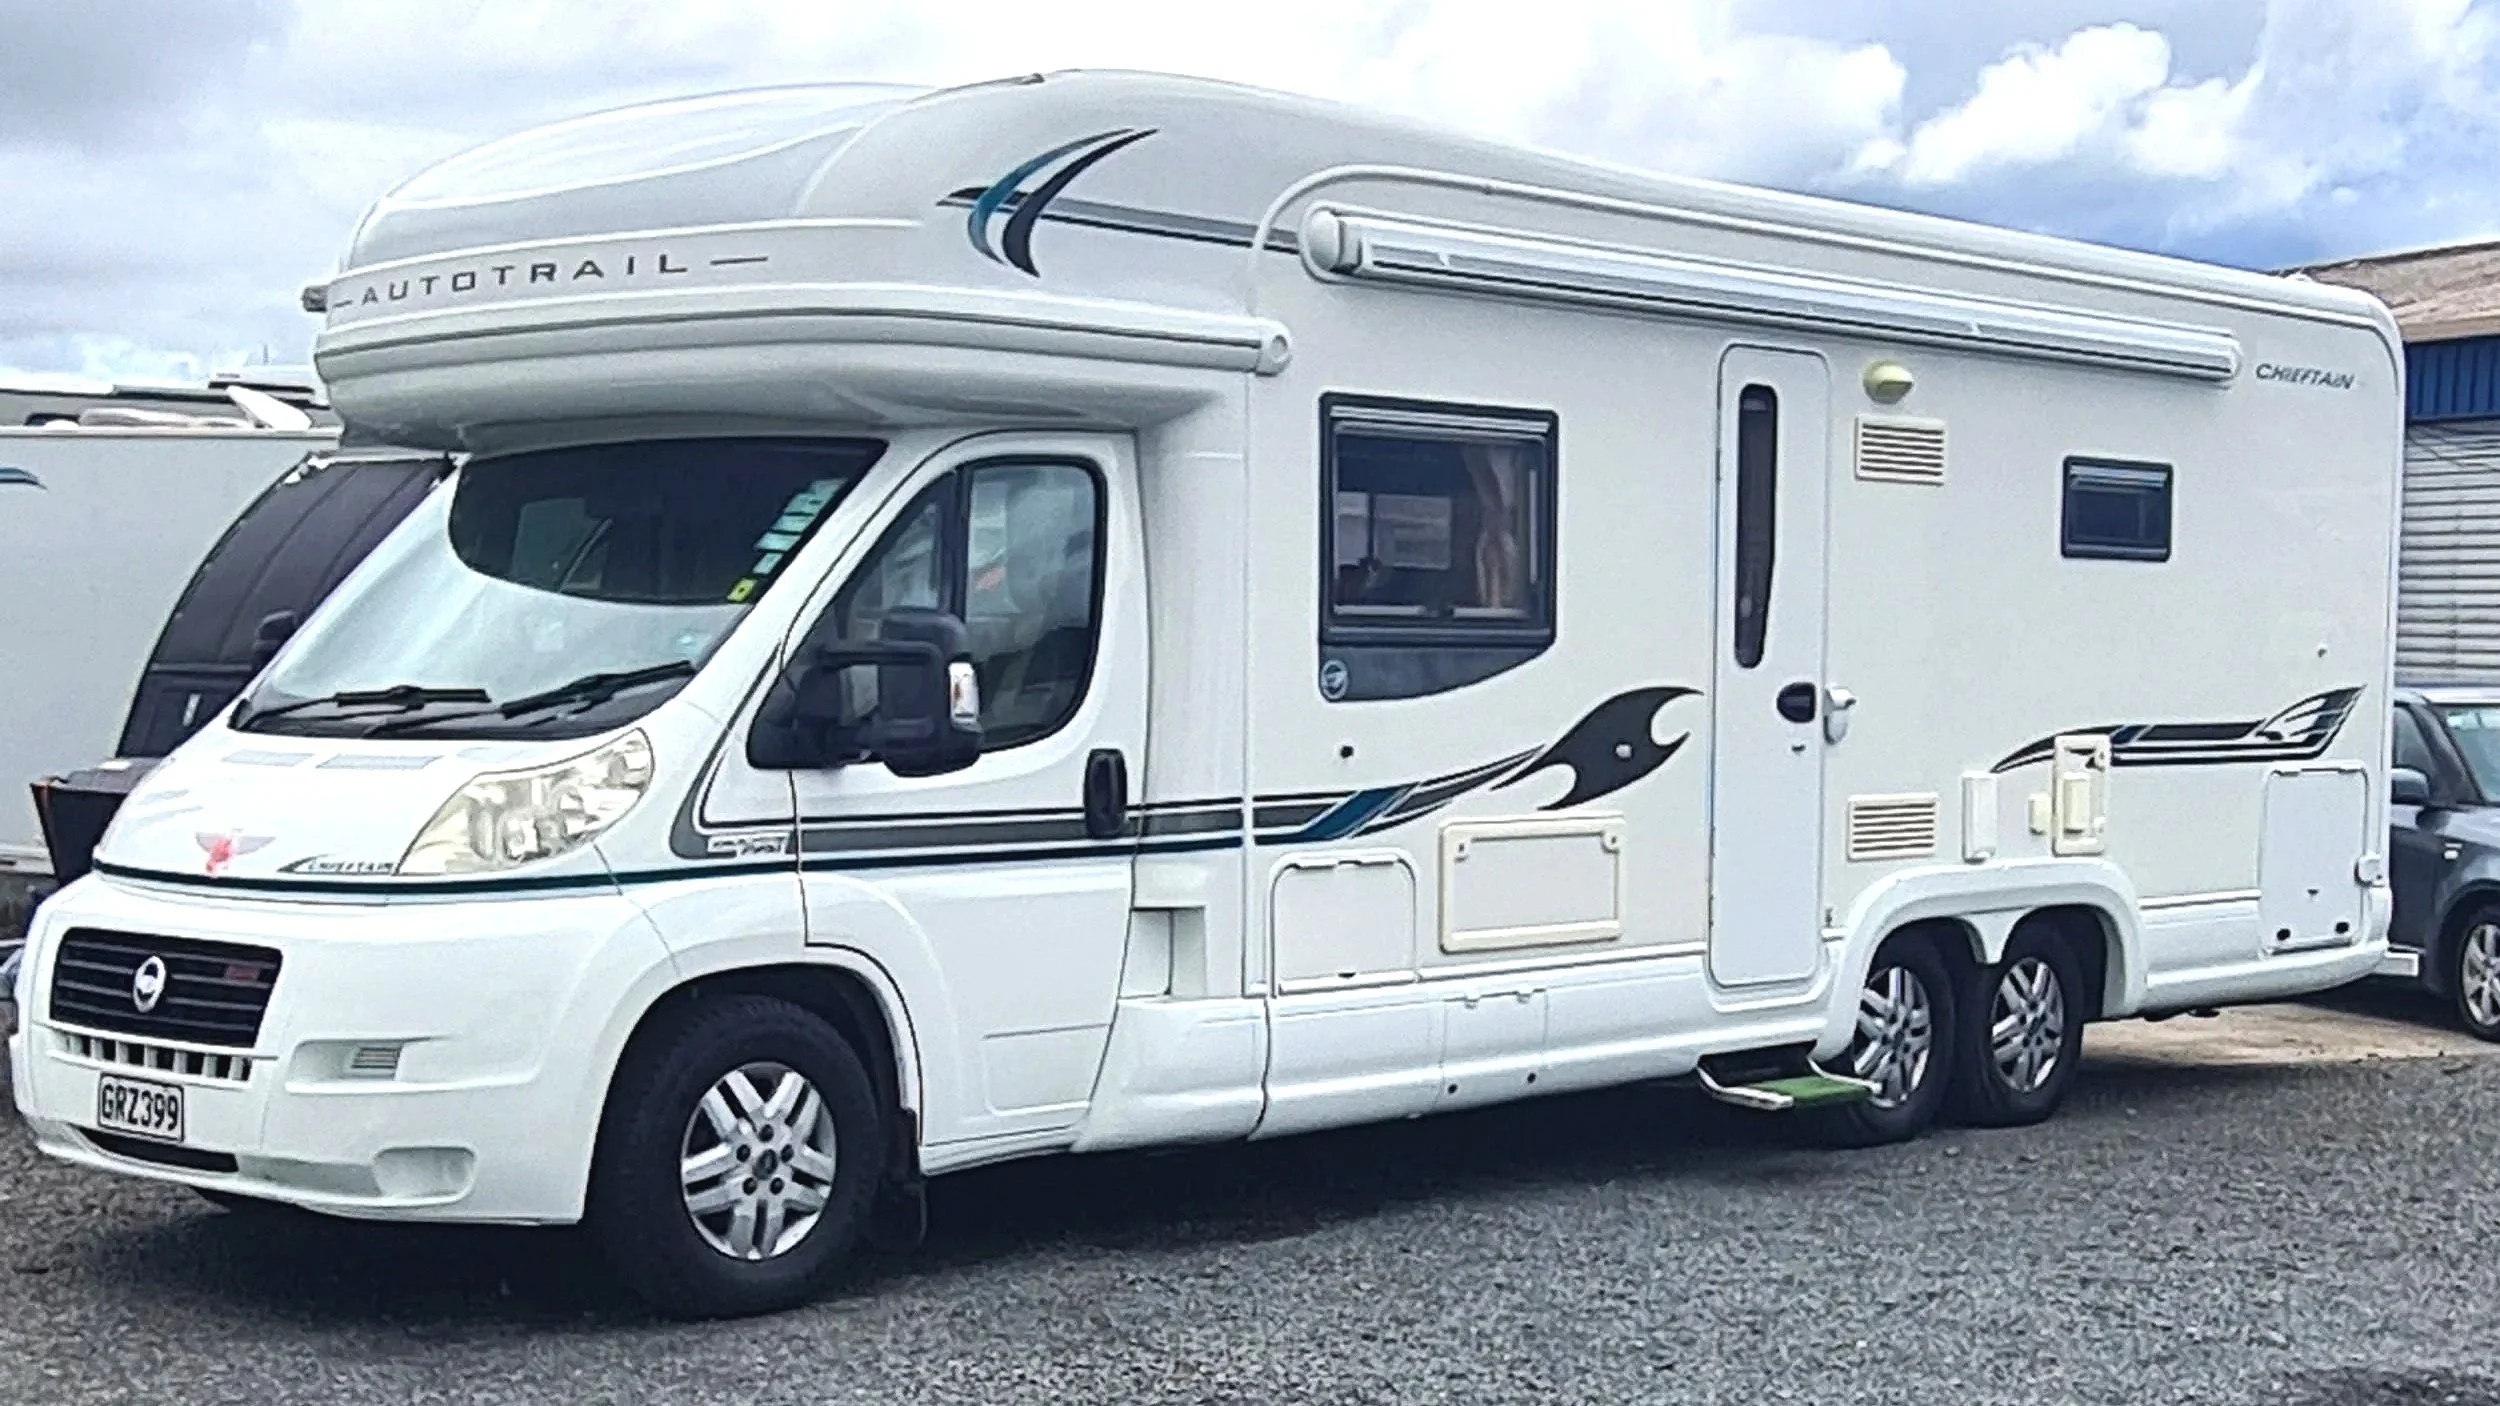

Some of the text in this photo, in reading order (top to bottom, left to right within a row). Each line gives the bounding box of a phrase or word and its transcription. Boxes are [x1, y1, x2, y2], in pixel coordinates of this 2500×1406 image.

[361, 253, 688, 305] AUTOTRAIL
[2255, 362, 2354, 390] CHIEFTAIN
[101, 1083, 179, 1132] GRZ399
